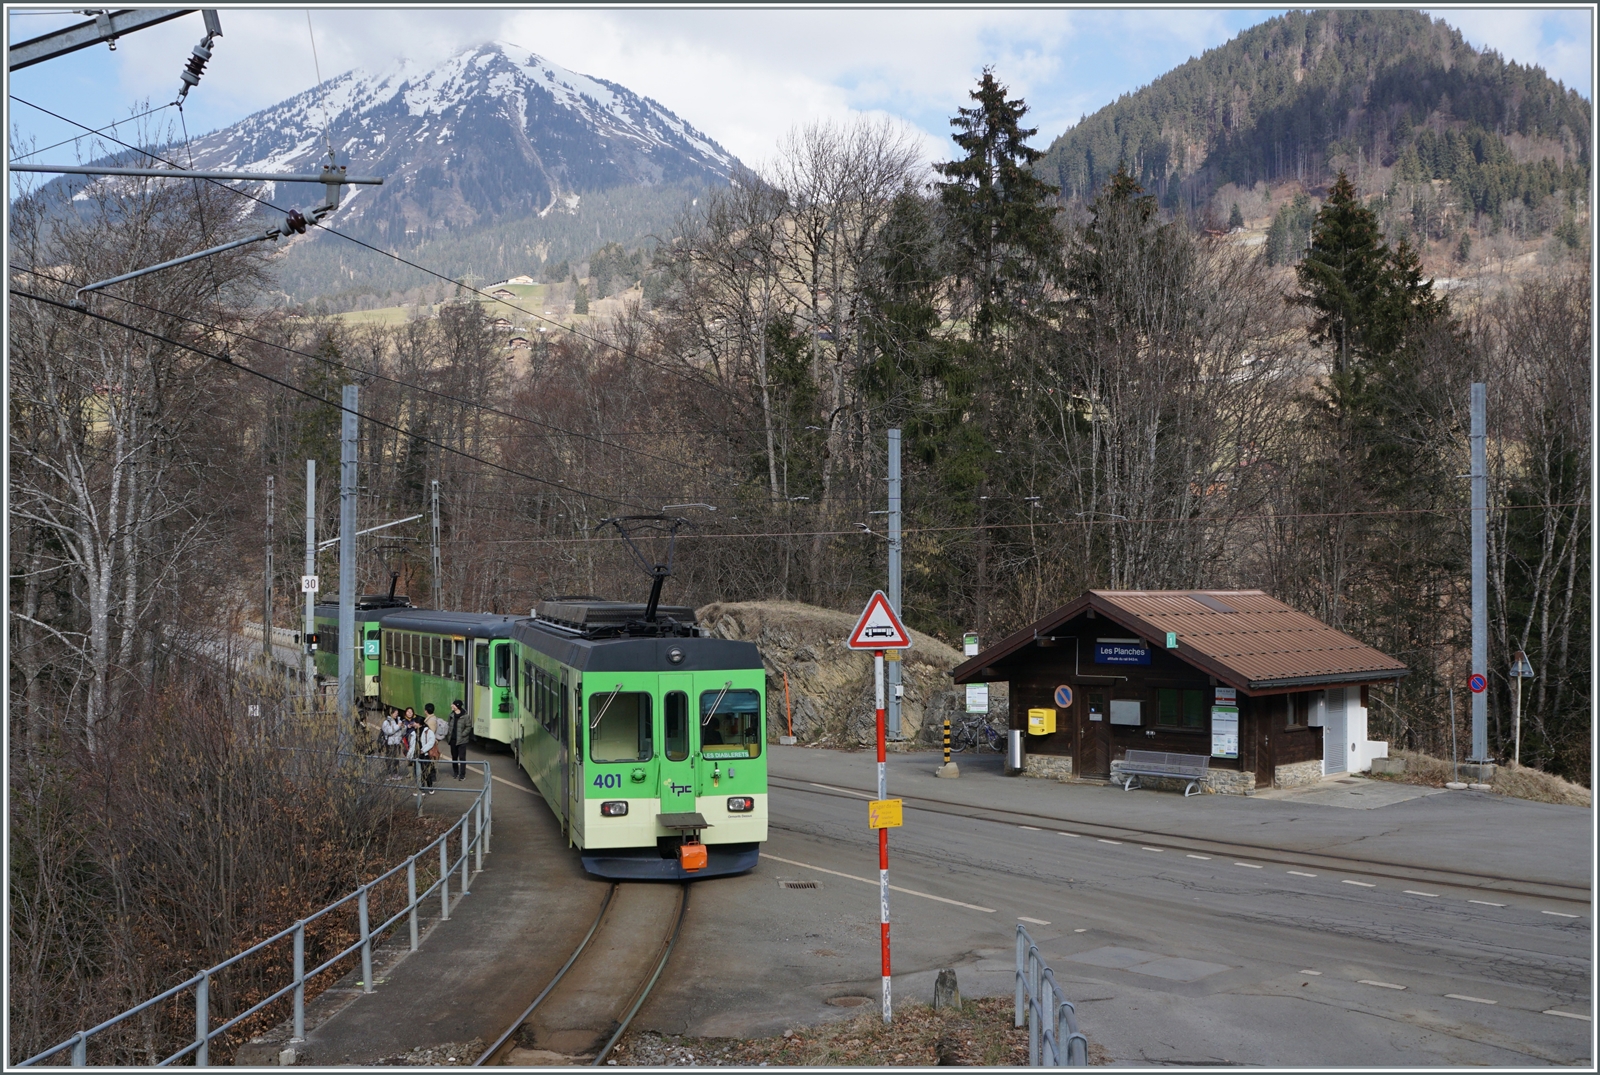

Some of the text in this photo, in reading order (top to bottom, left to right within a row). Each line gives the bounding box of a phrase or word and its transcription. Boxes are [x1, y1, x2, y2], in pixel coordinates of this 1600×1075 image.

[304, 579, 316, 589] 30
[368, 644, 375, 653] 2
[1100, 647, 1145, 656] Les Planches
[593, 773, 621, 788] 401
[670, 782, 692, 797] tpc
